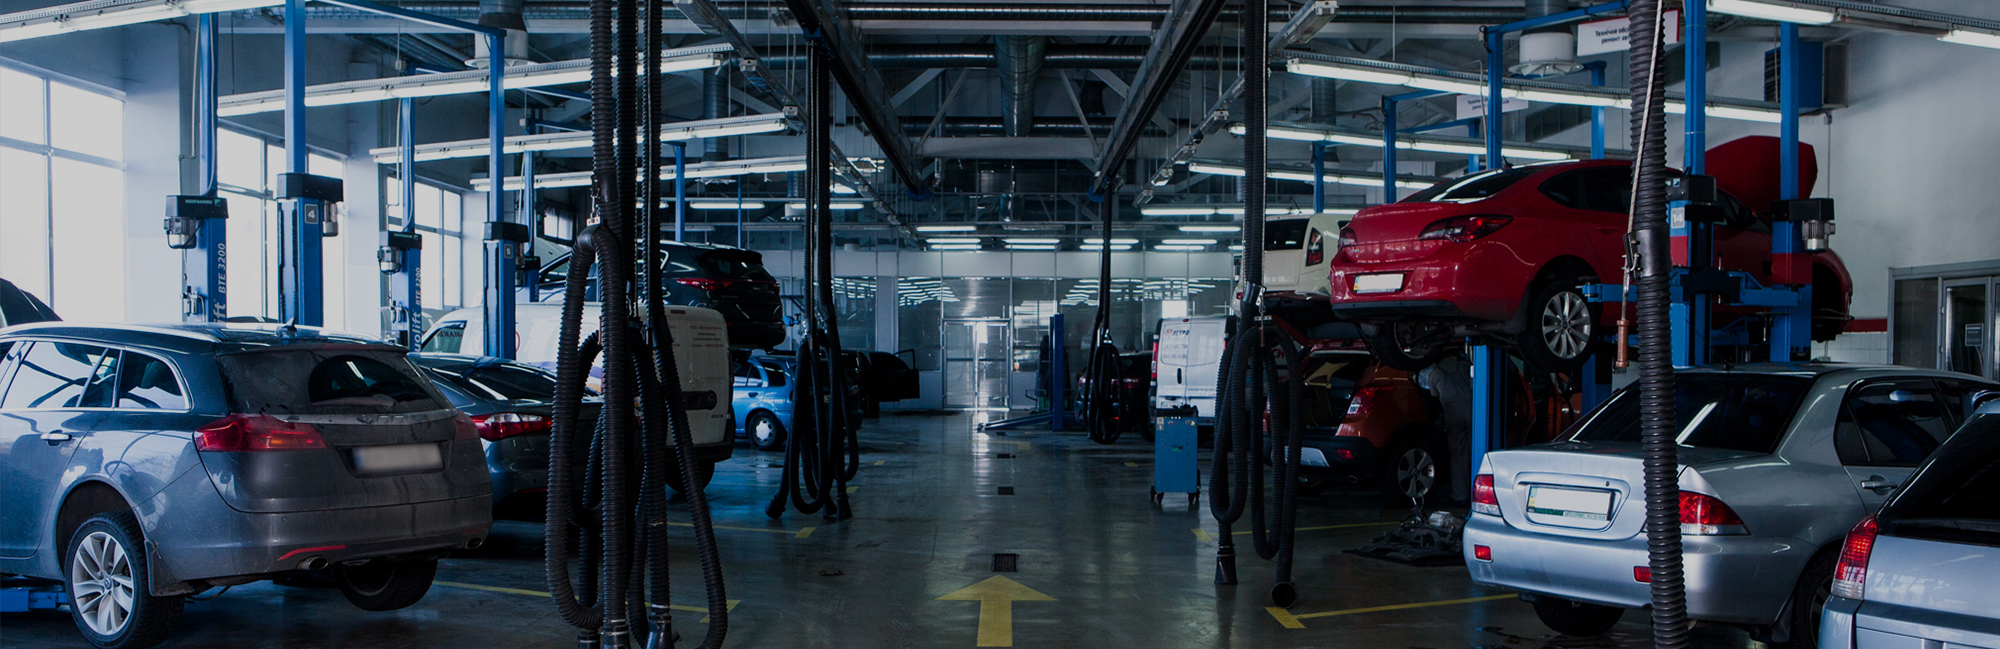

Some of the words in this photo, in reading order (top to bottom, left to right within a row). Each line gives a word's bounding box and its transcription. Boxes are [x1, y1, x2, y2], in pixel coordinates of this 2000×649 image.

[1601, 36, 1620, 44] ремонт
[308, 209, 316, 219] 4
[1673, 213, 1683, 223] 14
[217, 242, 226, 271] 3200
[218, 272, 226, 294] BTE
[411, 311, 421, 352] uolift
